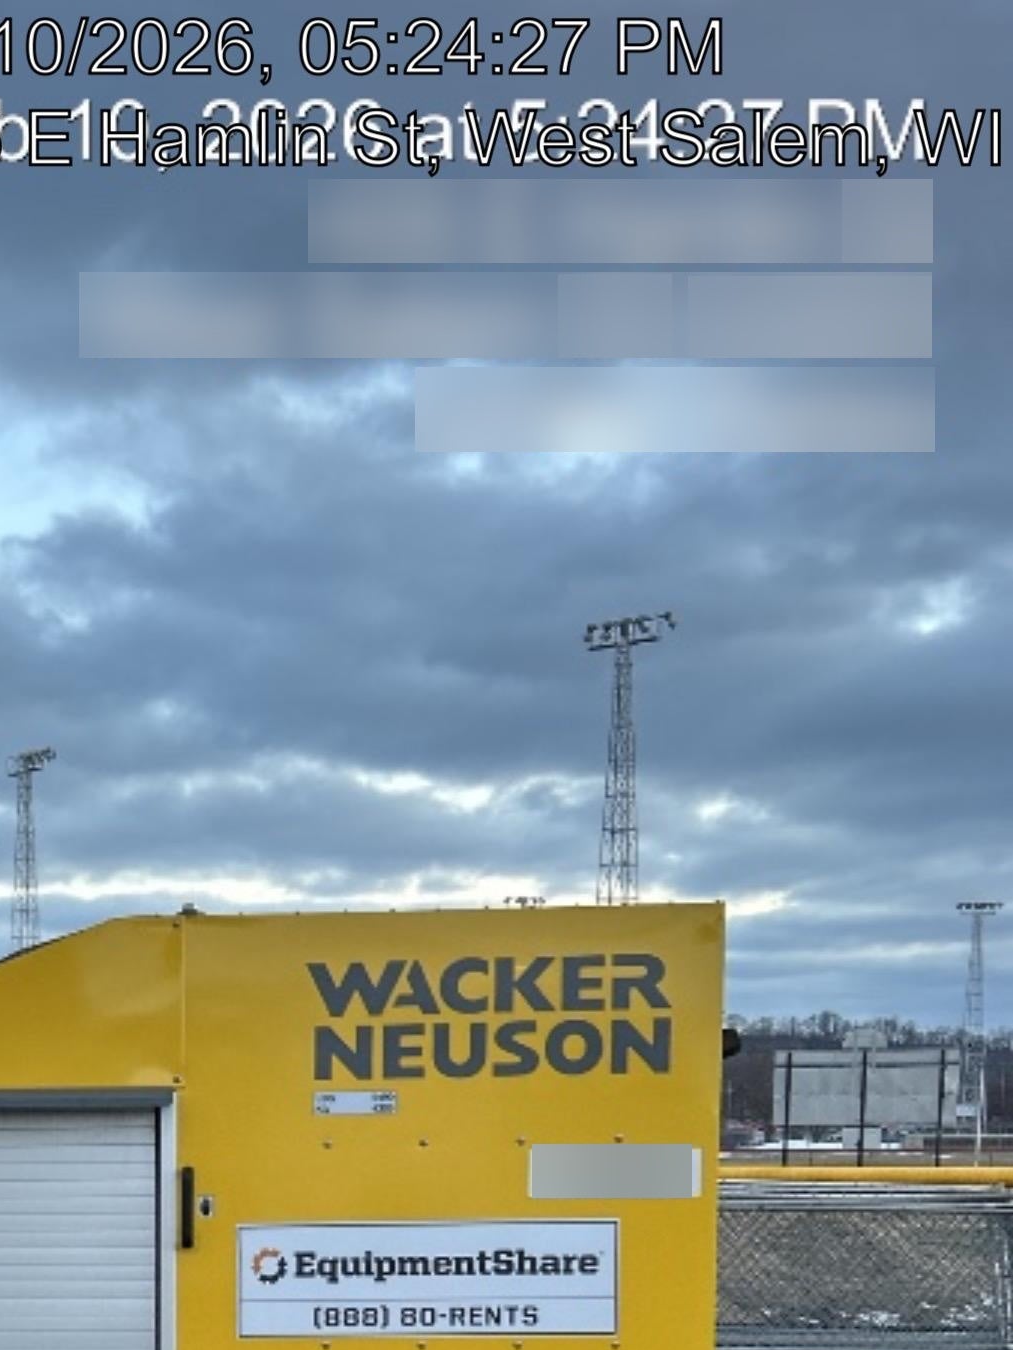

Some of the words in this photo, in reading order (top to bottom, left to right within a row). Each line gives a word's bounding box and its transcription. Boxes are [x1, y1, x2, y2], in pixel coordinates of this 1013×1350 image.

[305, 953, 673, 1018] WACKER
[313, 1017, 673, 1080] NEUSON
[293, 1250, 600, 1284] EquipmentShare
[312, 1305, 390, 1330] (888)
[400, 1304, 540, 1328] 80-RENTS
